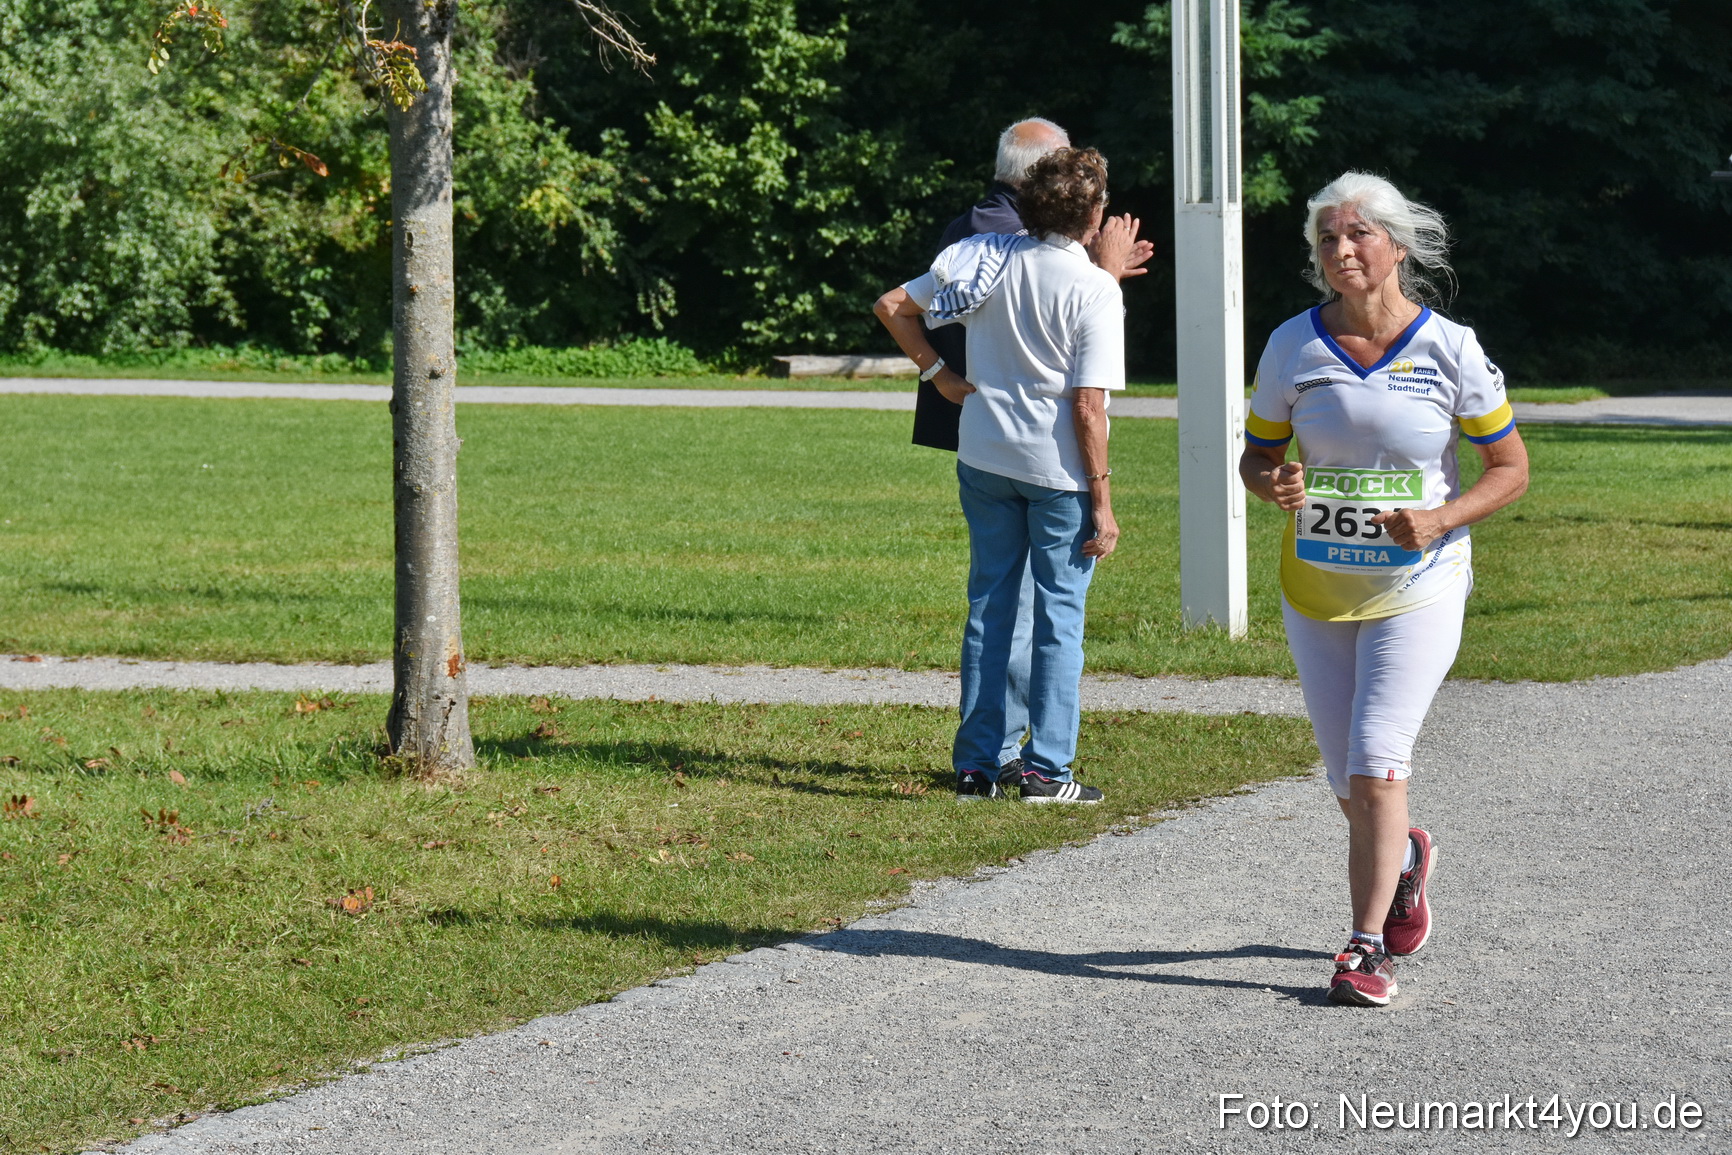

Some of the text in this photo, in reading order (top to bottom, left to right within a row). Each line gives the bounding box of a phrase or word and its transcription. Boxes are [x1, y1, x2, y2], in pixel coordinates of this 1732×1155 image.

[1391, 361, 1436, 376] 20 JAHRE
[1388, 374, 1442, 387] Neumarkter
[1387, 383, 1431, 395] Stadtlauf
[1310, 472, 1413, 497] BOCK
[1310, 504, 1402, 540] 263
[1327, 546, 1390, 563] PETRA
